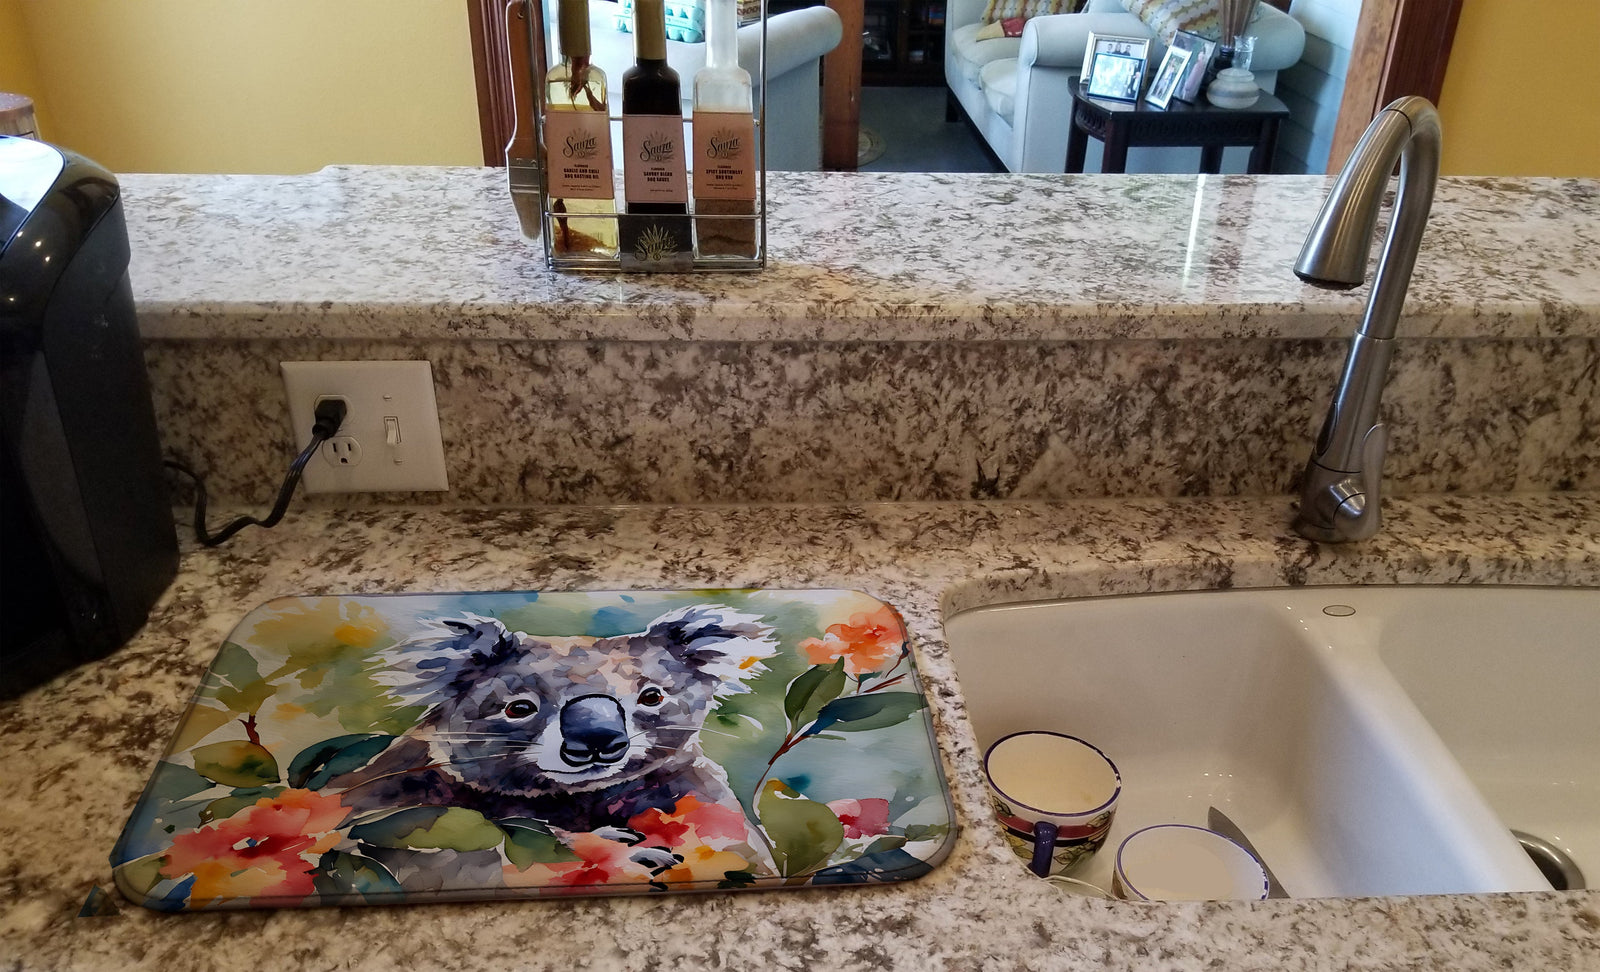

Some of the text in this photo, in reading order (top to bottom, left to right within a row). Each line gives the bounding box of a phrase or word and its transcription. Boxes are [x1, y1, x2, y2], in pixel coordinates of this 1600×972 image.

[562, 135, 598, 158] Sauza
[639, 140, 674, 162] Sauza
[706, 136, 740, 159] Sauza
